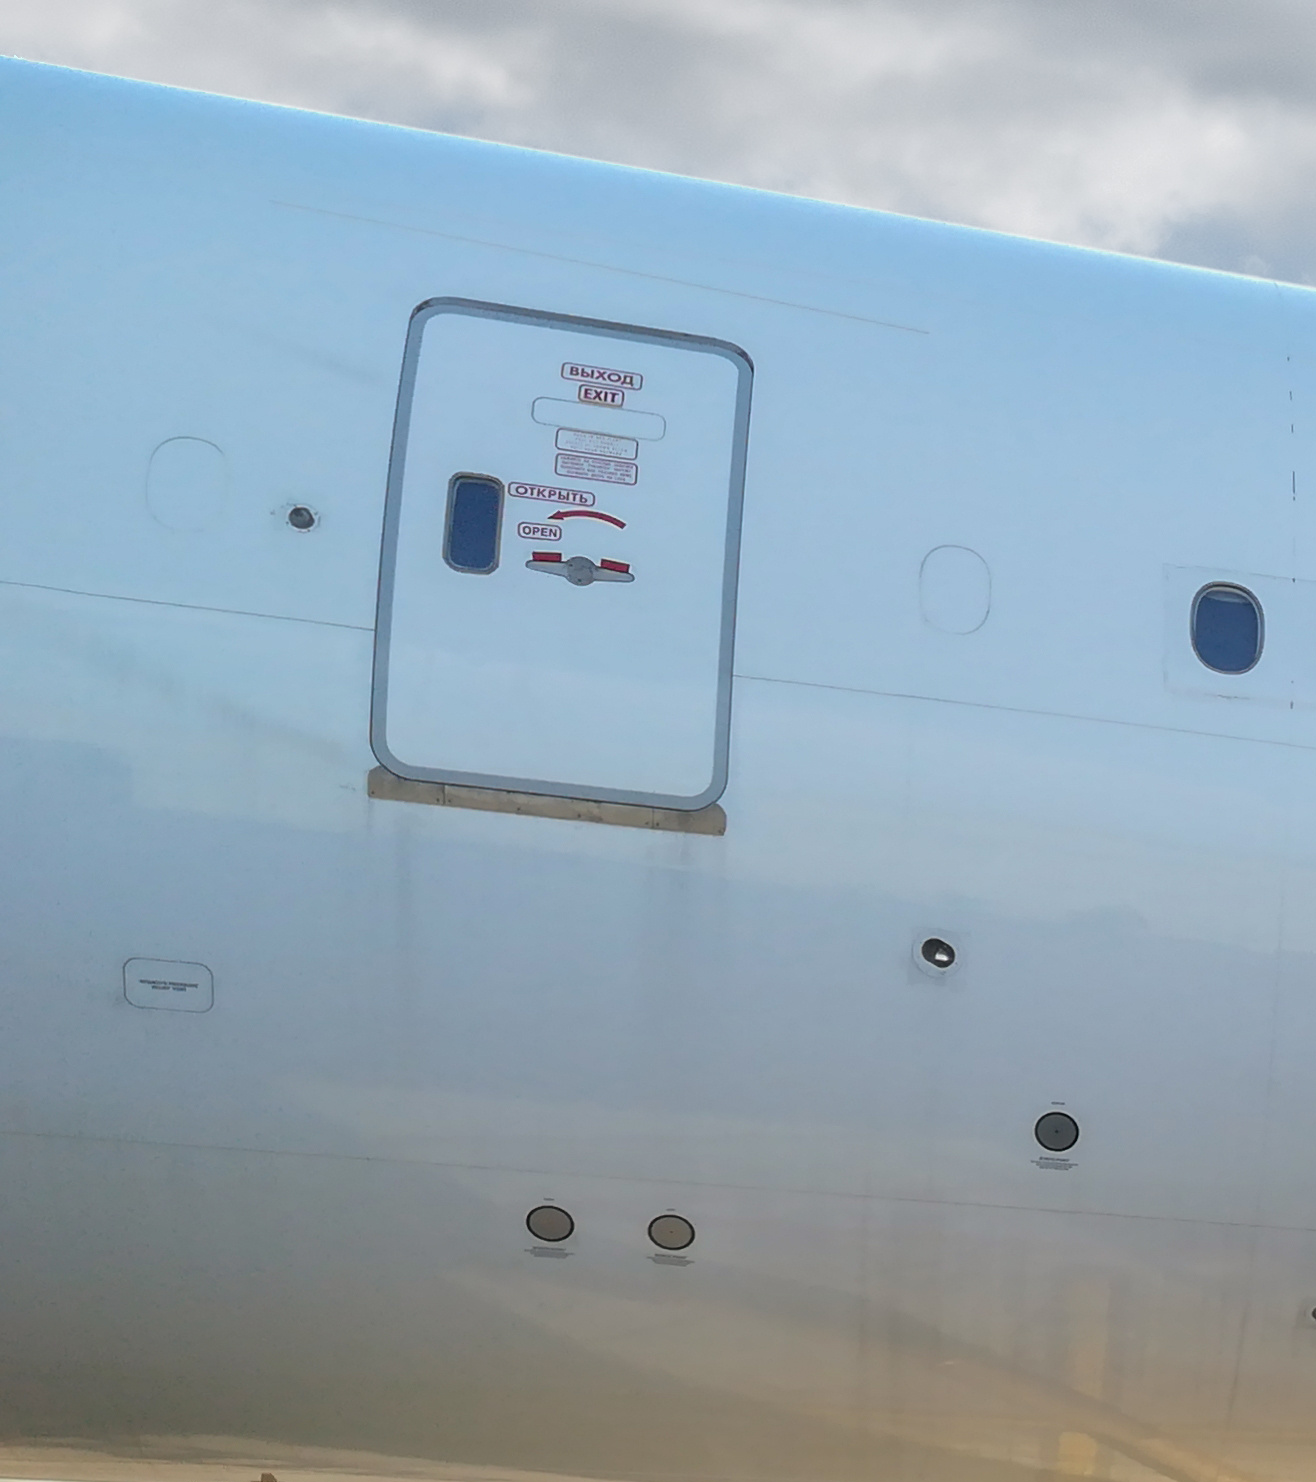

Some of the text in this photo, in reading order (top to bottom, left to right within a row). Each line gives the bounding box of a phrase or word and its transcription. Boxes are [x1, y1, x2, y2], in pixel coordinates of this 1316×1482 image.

[569, 366, 635, 387] ВЫХОД
[583, 388, 619, 403] EXIT
[515, 485, 588, 504] ОТКРЫТЬ
[522, 525, 558, 538] OPEN
